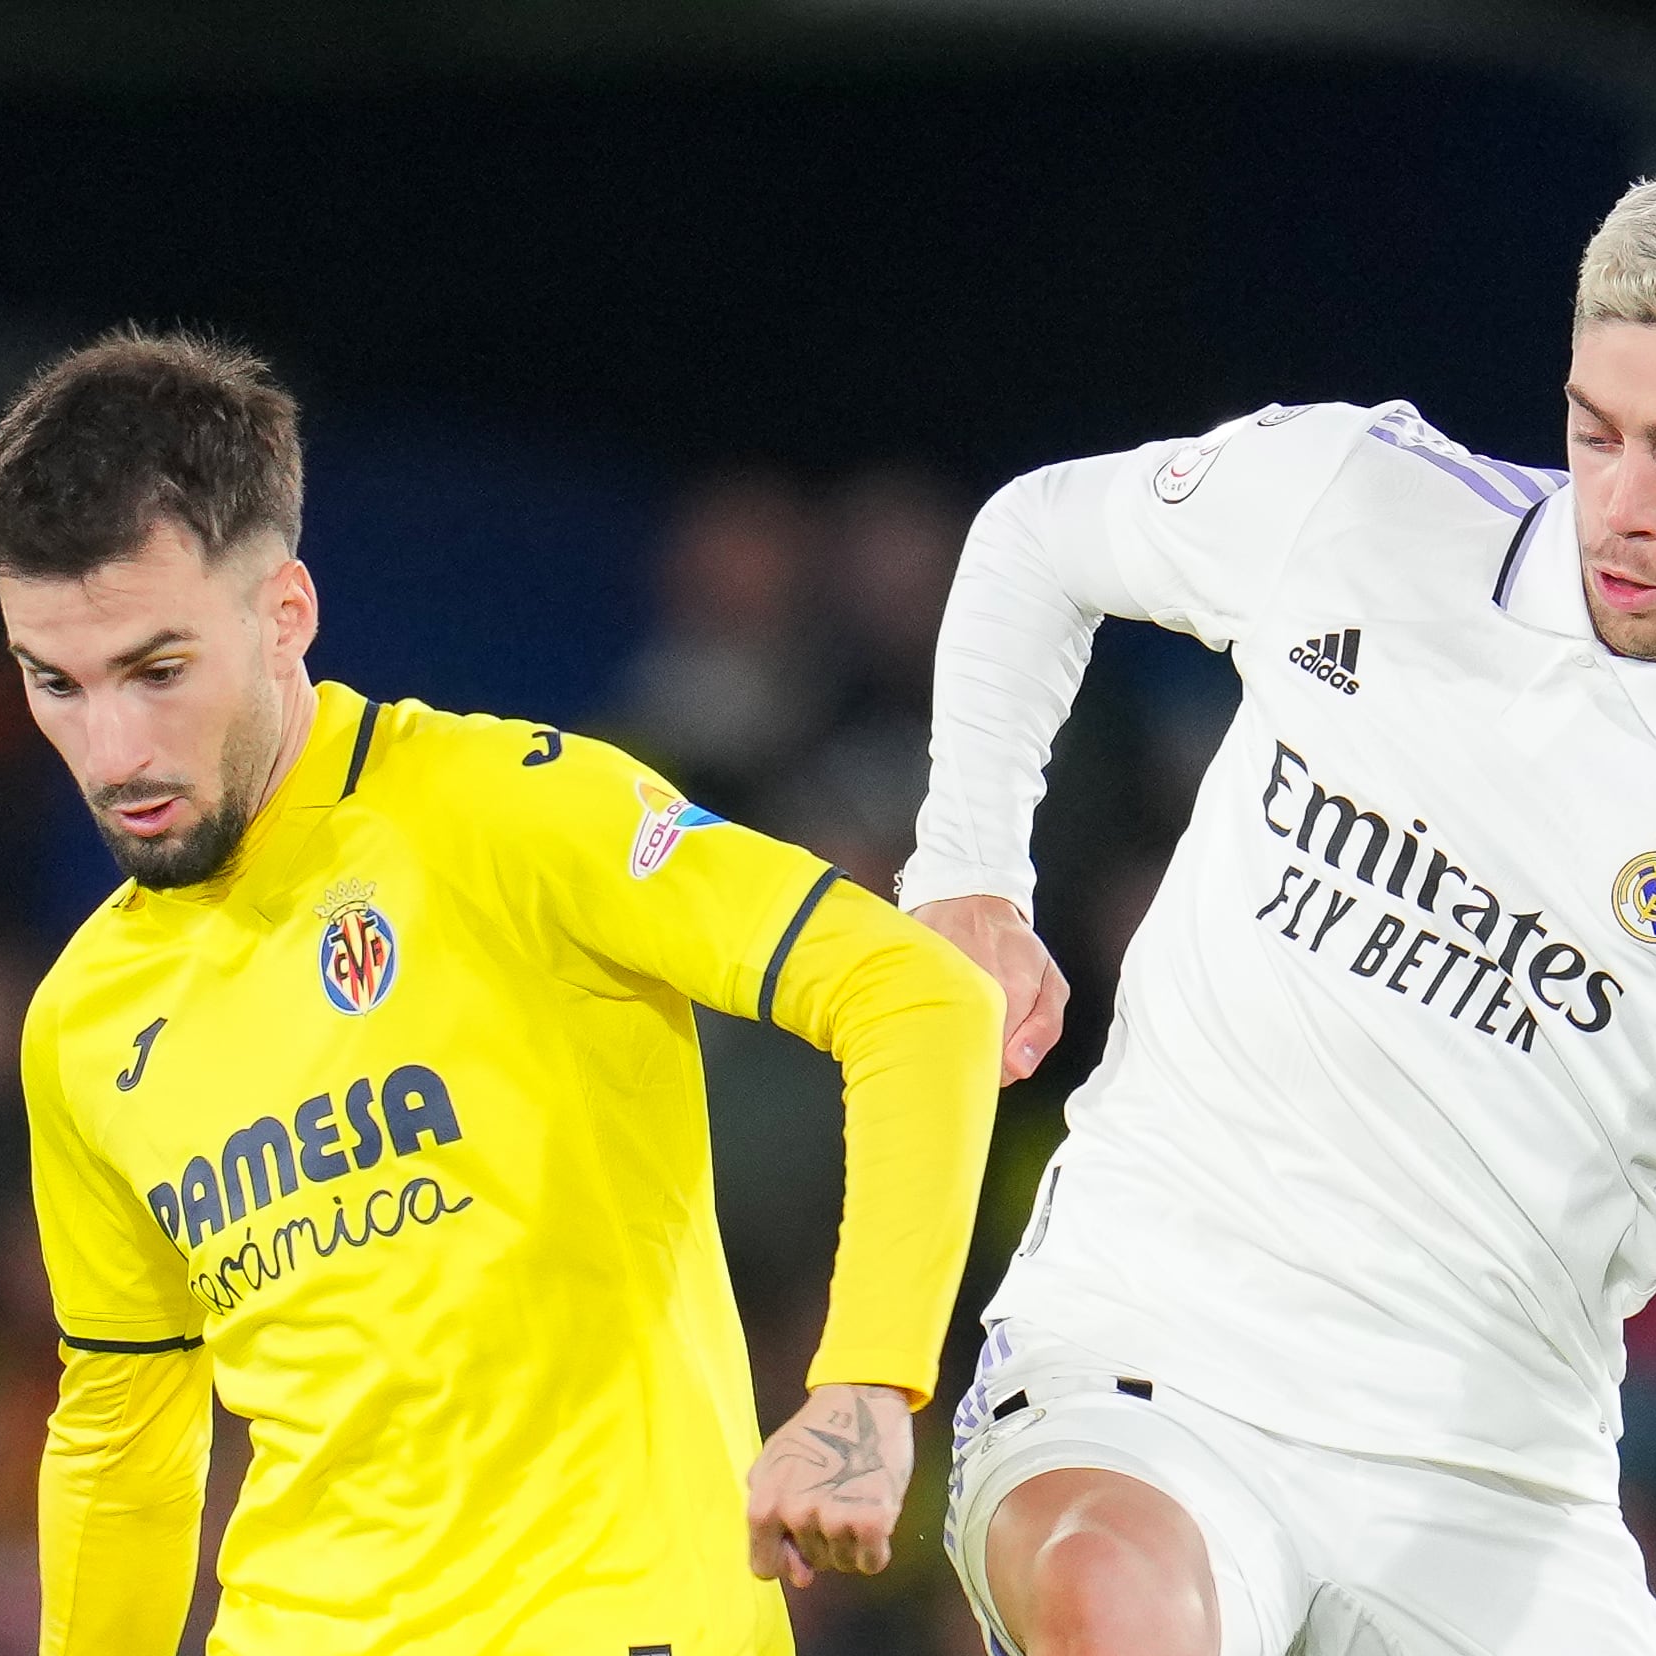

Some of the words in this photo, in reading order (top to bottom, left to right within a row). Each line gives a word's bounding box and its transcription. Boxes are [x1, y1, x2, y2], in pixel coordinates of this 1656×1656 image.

[1289, 646, 1359, 695] adidas
[1255, 865, 1357, 952] FLY
[1262, 739, 1625, 1033] Emirates
[147, 1064, 464, 1262] PAMESA
